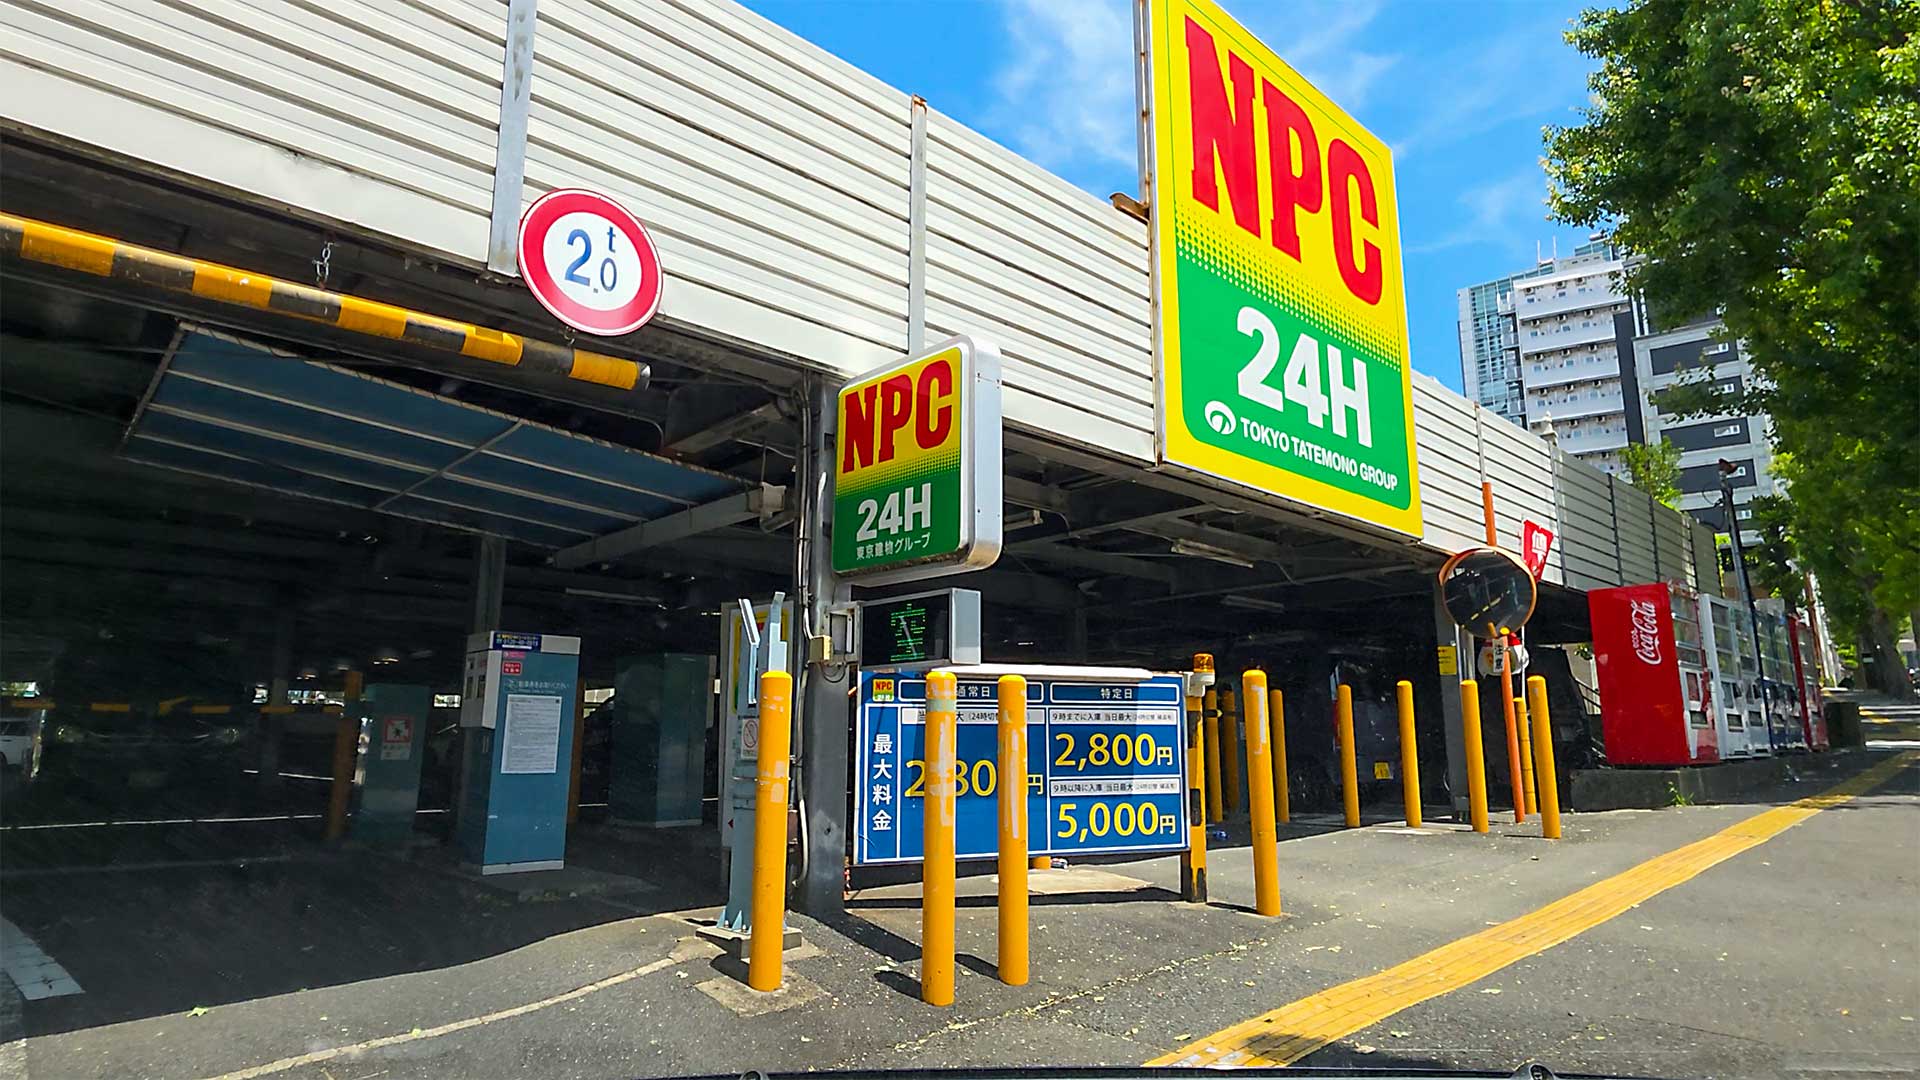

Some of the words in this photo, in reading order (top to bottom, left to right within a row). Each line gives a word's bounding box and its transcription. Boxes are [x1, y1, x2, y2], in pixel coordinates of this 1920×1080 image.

[1185, 14, 1383, 306] NPC
[1237, 306, 1372, 448] 24H
[843, 360, 952, 474] NPC
[1240, 417, 1290, 453] TOKYO
[1291, 436, 1358, 477] TATEMONO
[1359, 462, 1398, 491] GROUP
[856, 482, 931, 542] 24H
[856, 532, 931, 561] 東京建物グループ
[1631, 600, 1662, 665] Coca-Cola
[875, 681, 893, 691] NPC
[956, 685, 990, 697] 通常日
[1101, 688, 1133, 699] 特定日
[1055, 733, 1173, 771] 2,800円
[872, 734, 893, 831] 最大料金
[1057, 802, 1176, 842] 5,000円
